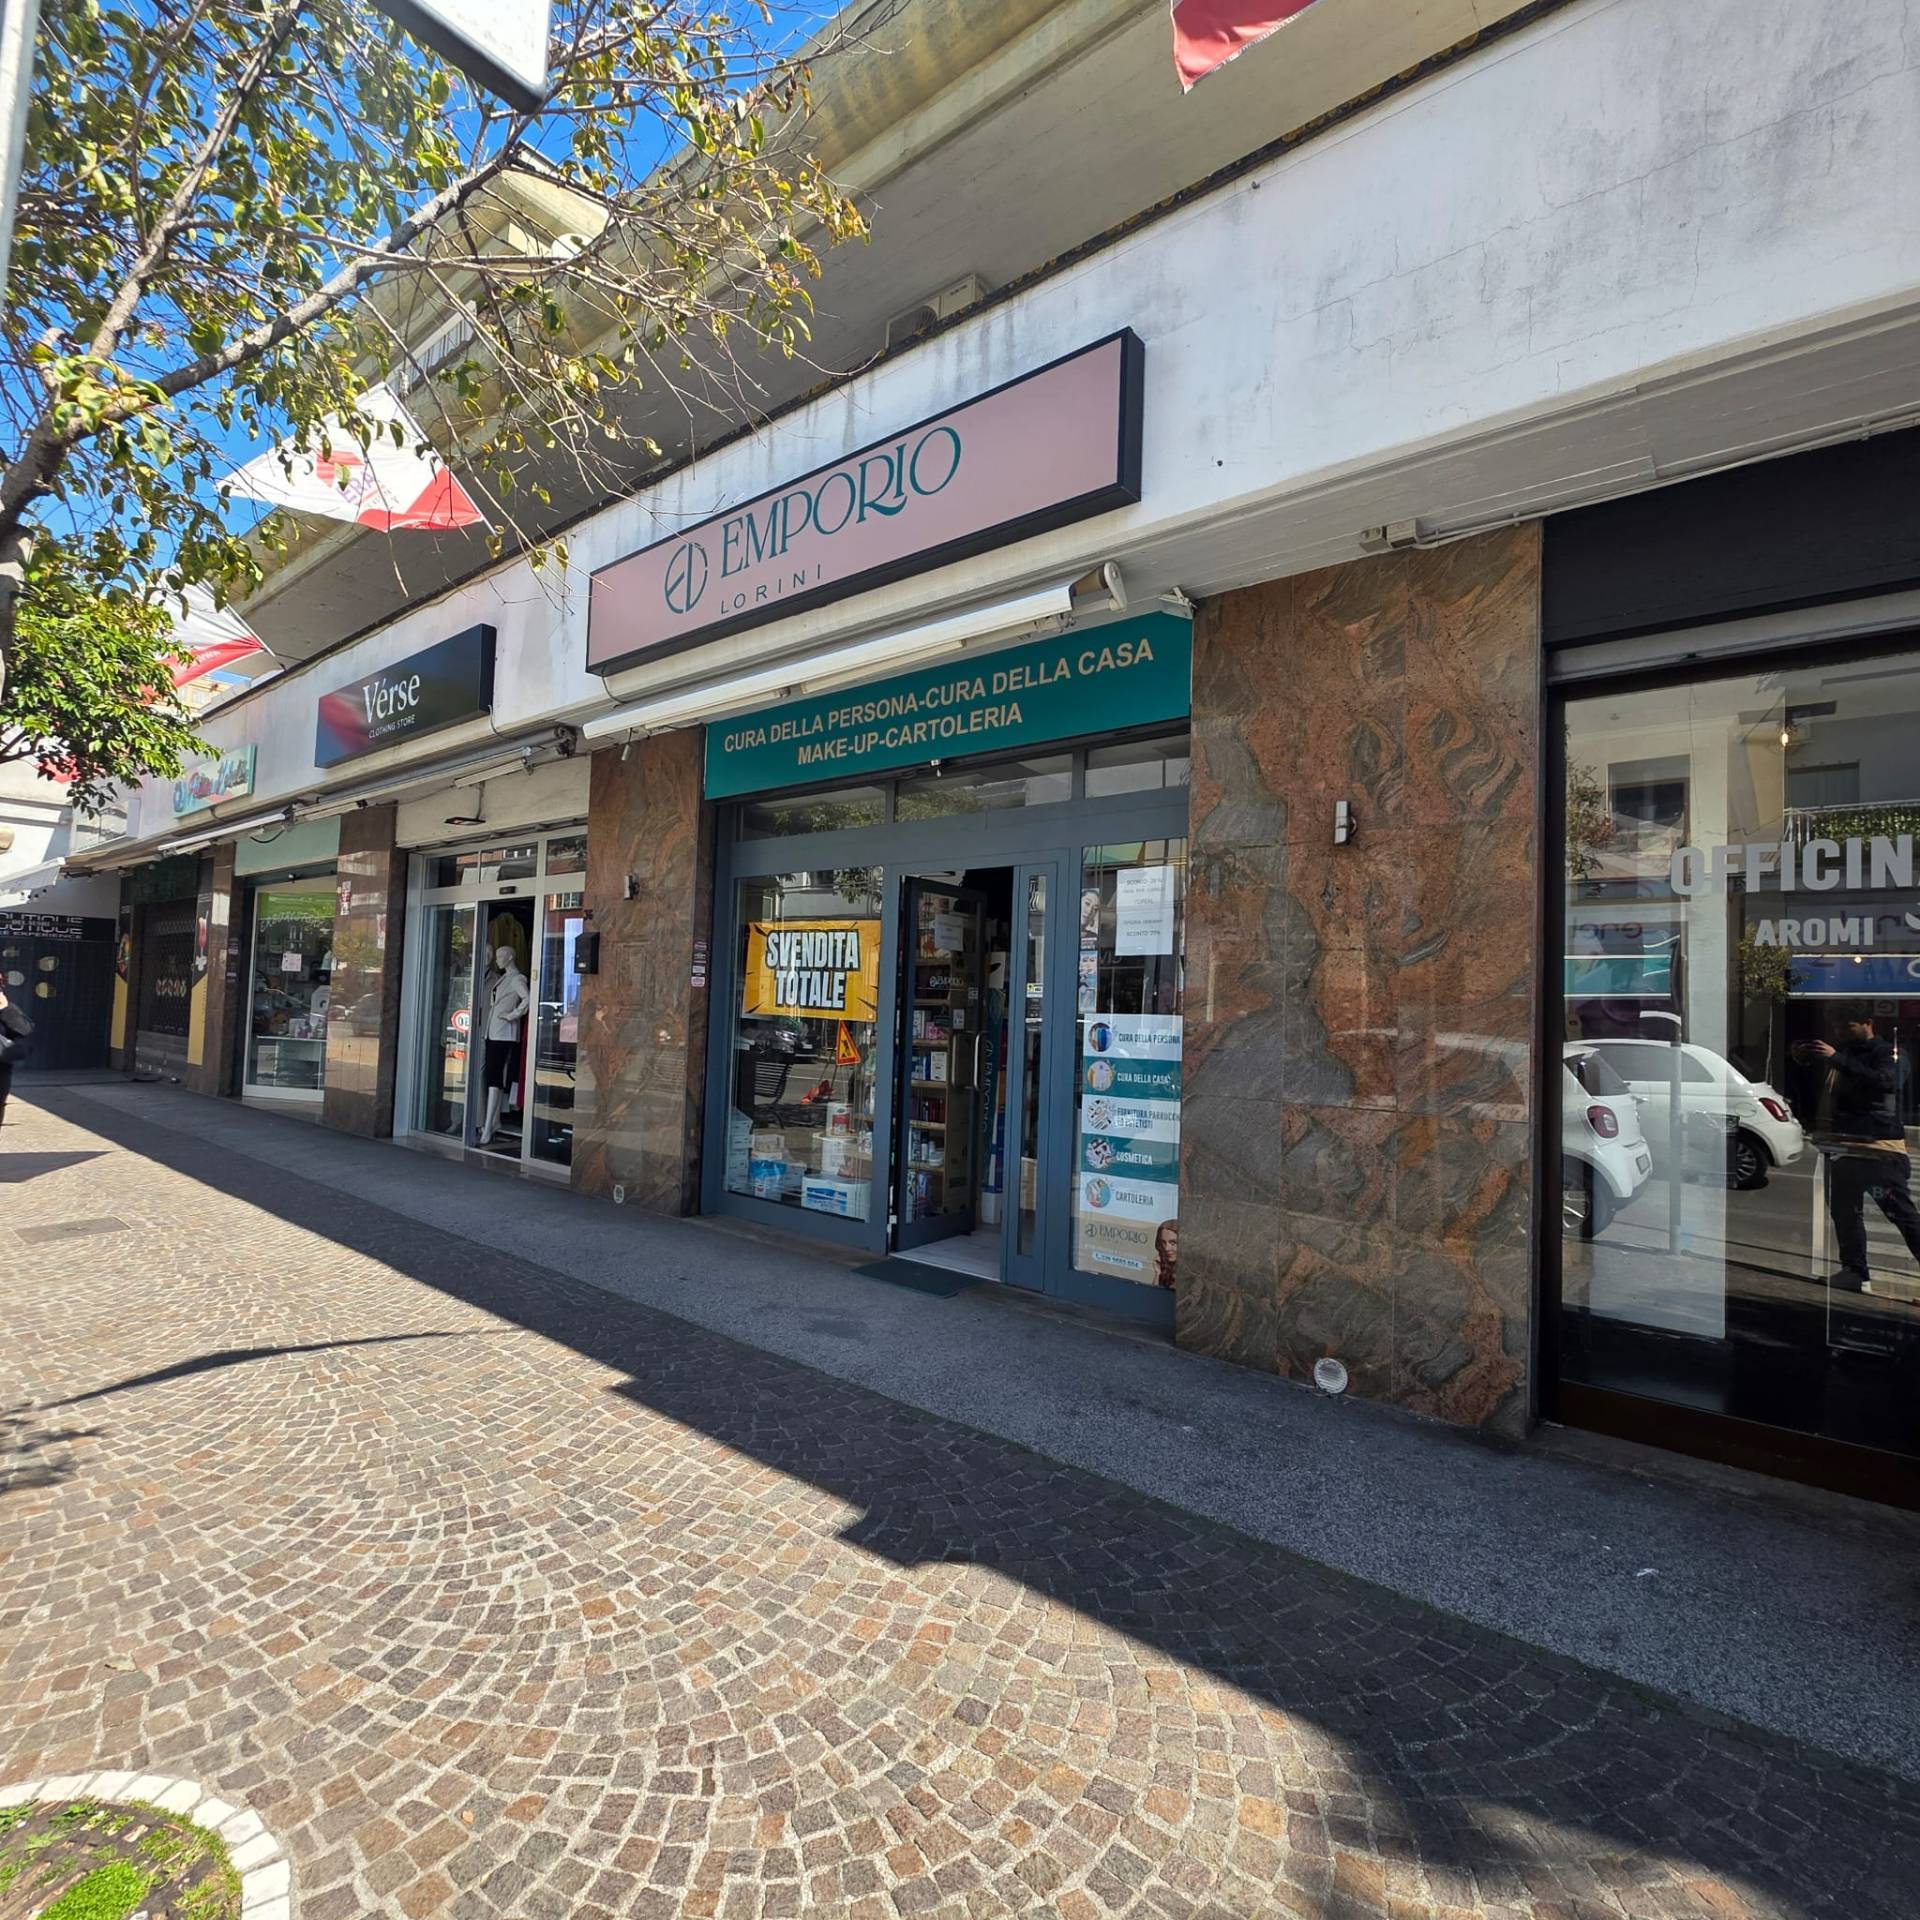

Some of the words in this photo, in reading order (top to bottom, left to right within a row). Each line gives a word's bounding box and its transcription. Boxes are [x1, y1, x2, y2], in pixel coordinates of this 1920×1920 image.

[721, 426, 962, 578] EMPORIO
[720, 563, 822, 615] LORINI
[362, 674, 421, 724] Vérse
[724, 730, 767, 752] CURA
[770, 714, 824, 743] DELLA
[828, 677, 986, 731] PERSONA-CURA
[992, 657, 1072, 696] DELLA
[1078, 638, 1154, 676] CASA
[368, 721, 396, 739] CLOTHING
[396, 713, 417, 730] STORE
[797, 702, 1023, 766] MAKE-UP-CARTOLERIA
[1670, 834, 1920, 895] OFFICIN
[766, 930, 860, 970] SVENDITA
[1754, 917, 1874, 947] AROMI
[775, 970, 846, 1009] TOTALE
[1118, 1033, 1133, 1043] CURA
[1134, 1033, 1152, 1044] DELLA
[1117, 1072, 1133, 1083] CURA
[1133, 1073, 1152, 1084] DELLA
[1116, 1151, 1153, 1165] COSMETICA
[1115, 1191, 1154, 1207] CARTOLERIA
[1100, 1223, 1149, 1245] EMPORIO
